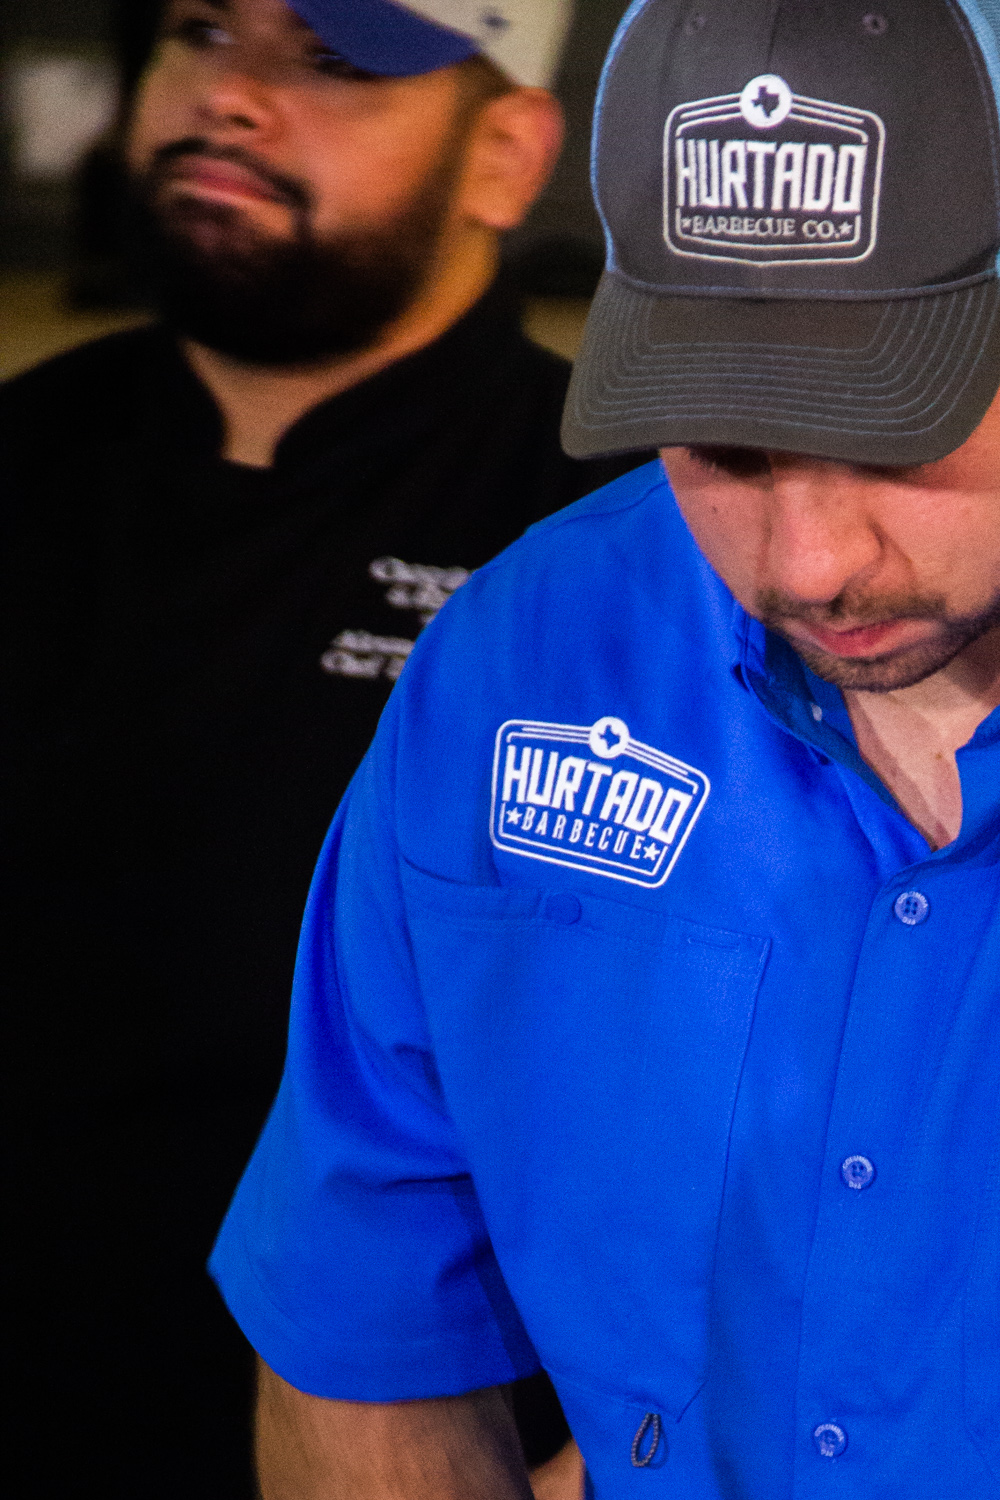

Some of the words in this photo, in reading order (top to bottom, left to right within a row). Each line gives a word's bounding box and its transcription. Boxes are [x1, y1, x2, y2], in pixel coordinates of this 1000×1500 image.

[675, 137, 869, 213] HURTADO
[691, 215, 797, 237] BARBECUE
[501, 744, 693, 845] HURTADO
[521, 806, 646, 860] BARBECUE
